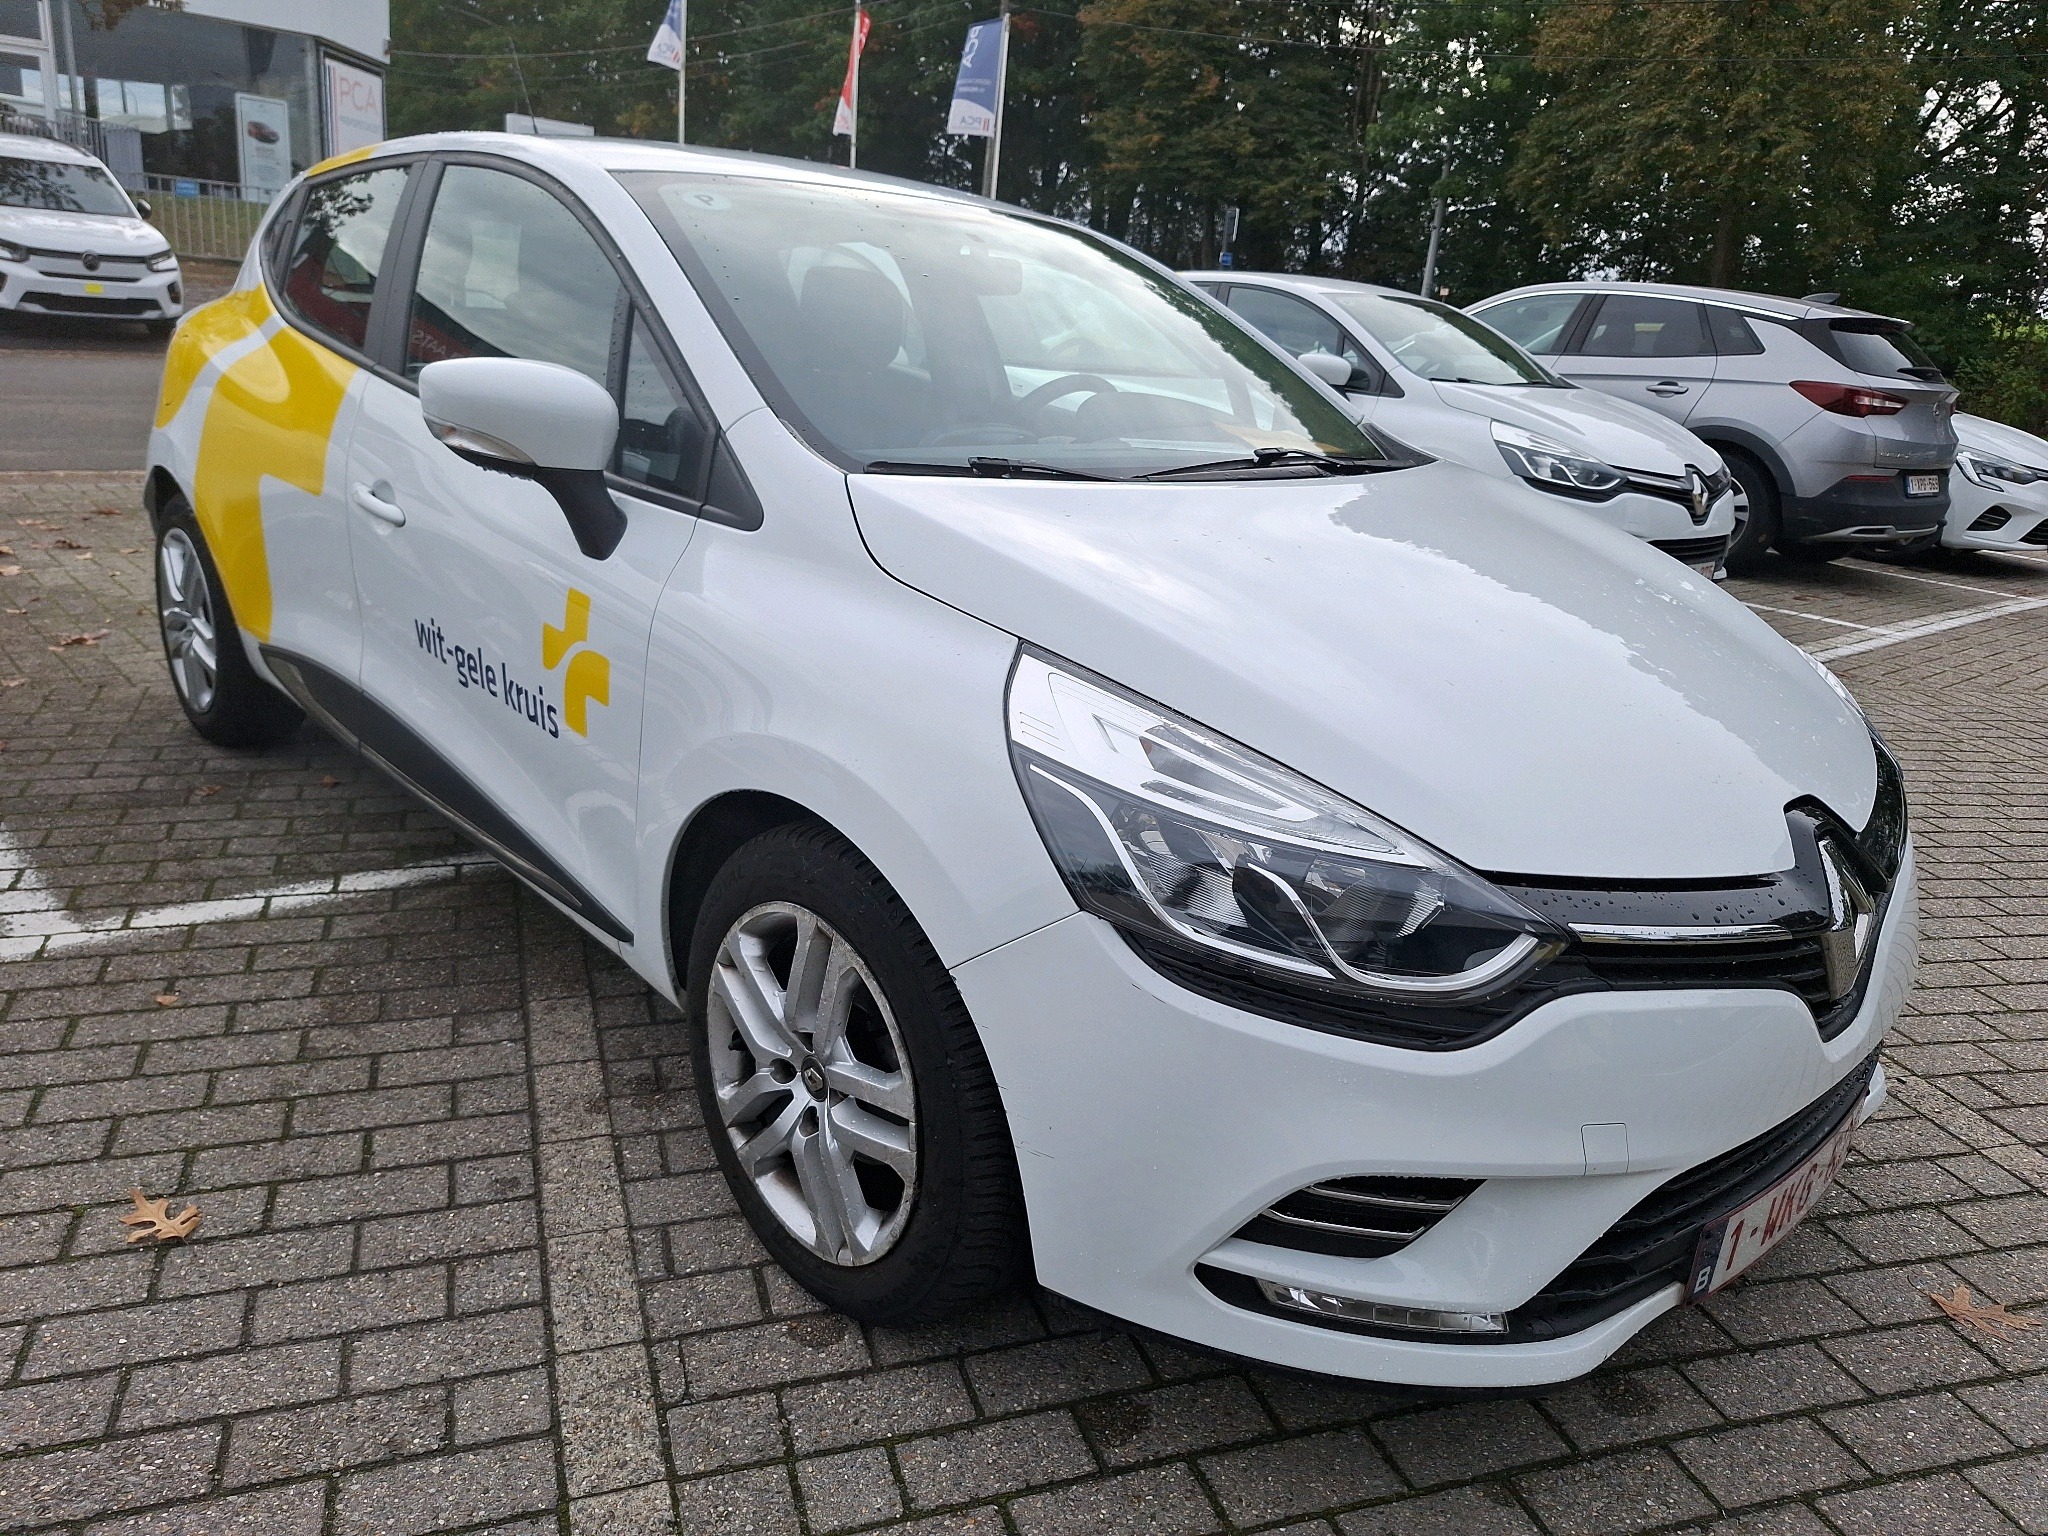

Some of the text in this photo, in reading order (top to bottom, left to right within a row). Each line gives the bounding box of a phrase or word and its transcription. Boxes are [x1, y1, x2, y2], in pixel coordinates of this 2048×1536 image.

[340, 76, 378, 112] PCA
[415, 617, 560, 739] wit-gele kruis
[1693, 1265, 1711, 1293] B
